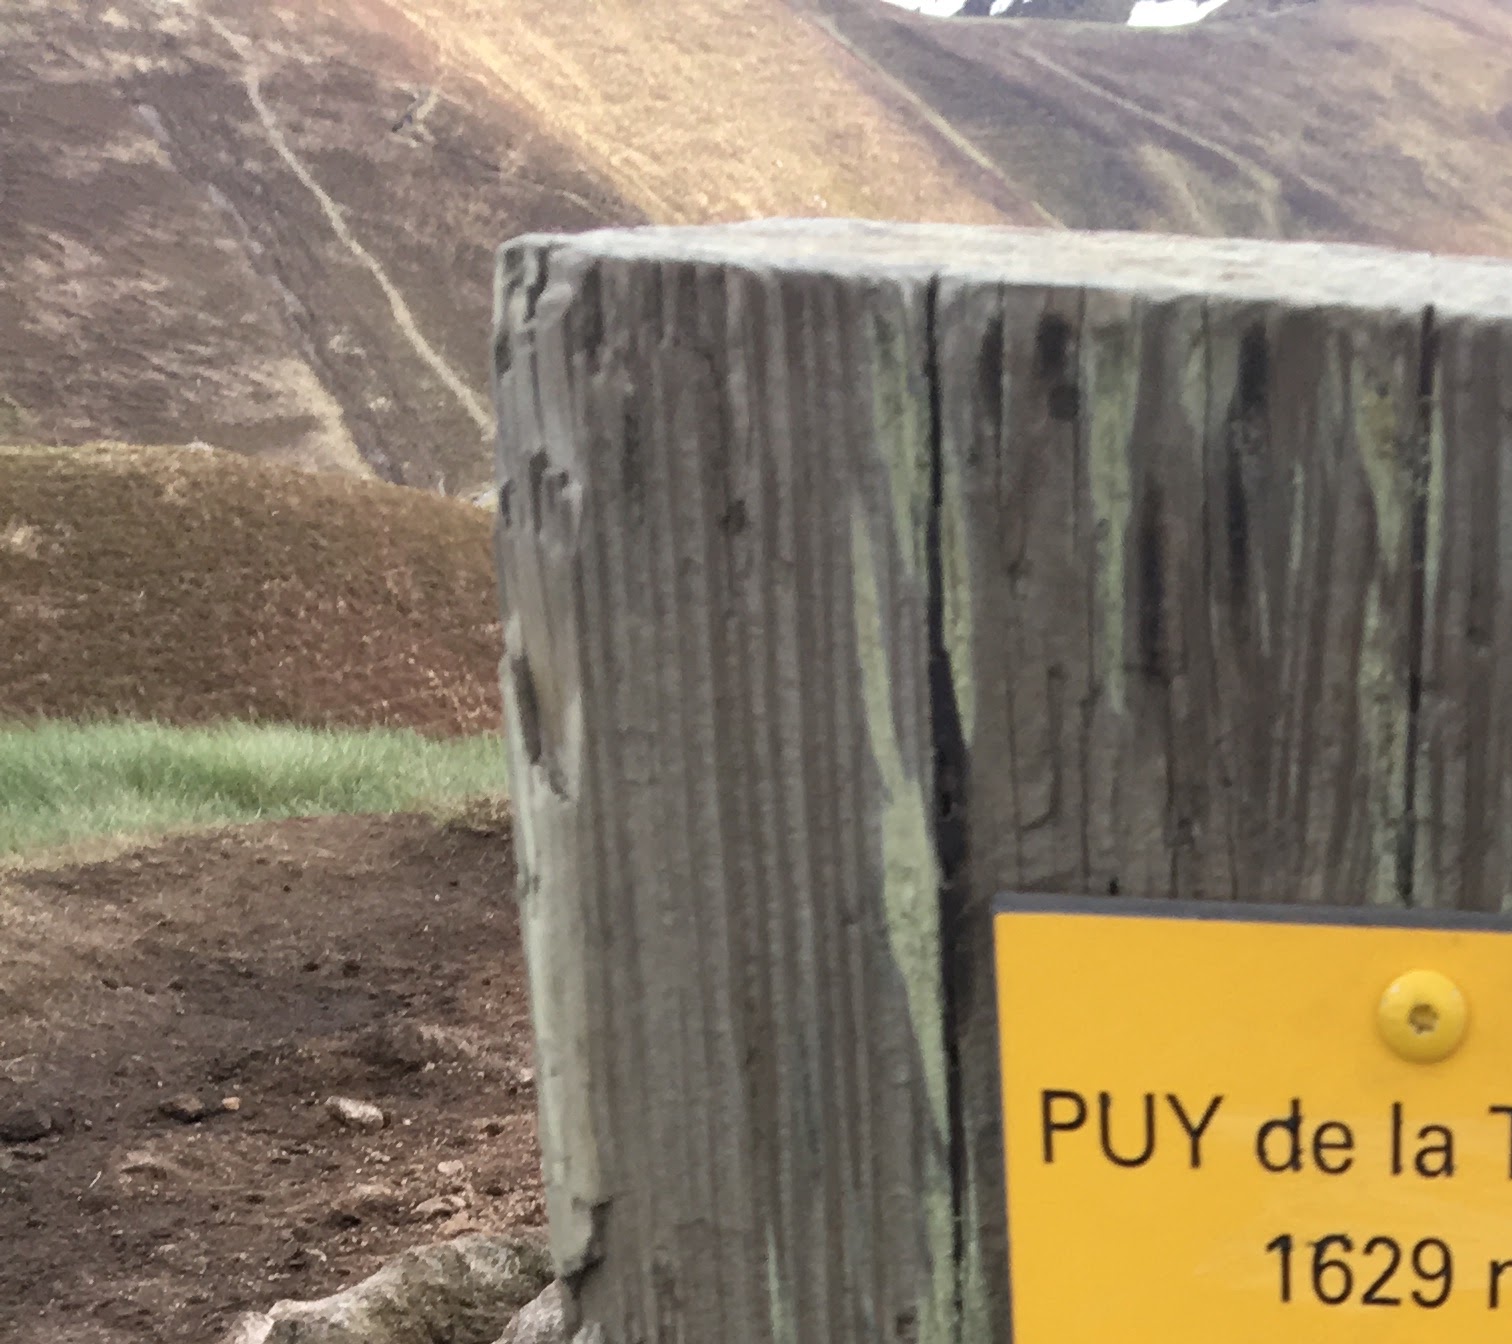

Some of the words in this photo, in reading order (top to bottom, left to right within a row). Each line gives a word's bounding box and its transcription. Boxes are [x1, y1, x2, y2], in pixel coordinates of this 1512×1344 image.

[1040, 1089, 1223, 1169] PUY
[1256, 1098, 1355, 1176] de
[1390, 1103, 1455, 1177] la
[1265, 1233, 1452, 1309] 1629
